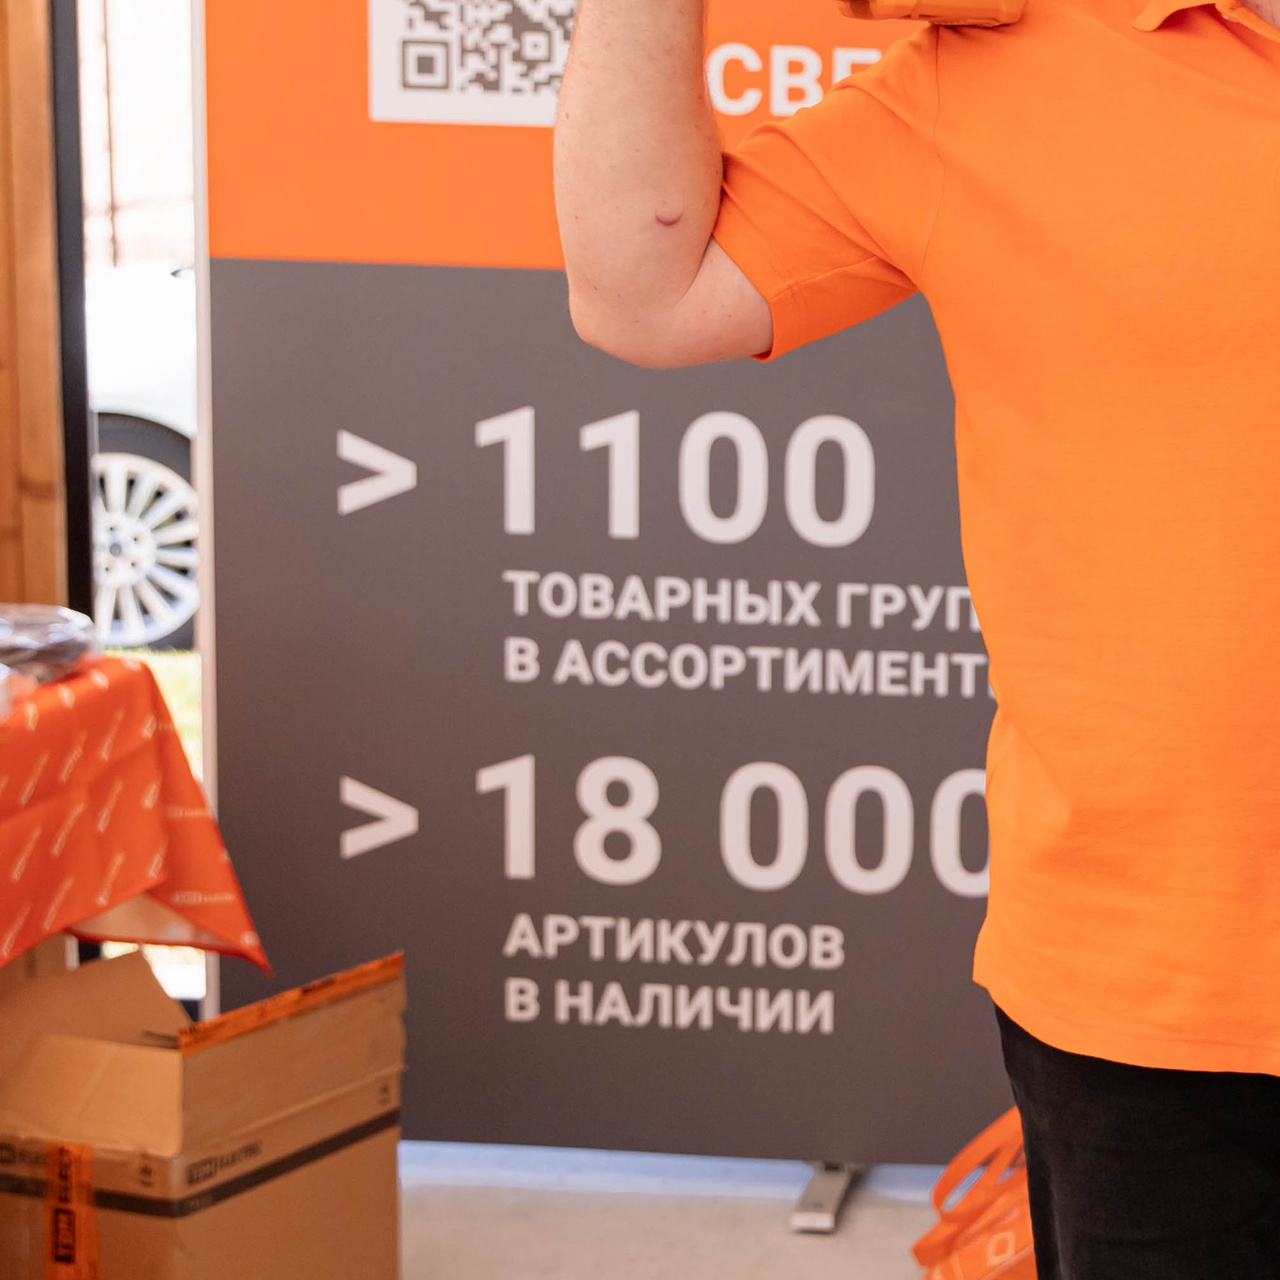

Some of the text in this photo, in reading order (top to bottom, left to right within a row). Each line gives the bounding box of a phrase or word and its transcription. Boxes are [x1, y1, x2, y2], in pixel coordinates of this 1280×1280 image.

[474, 405, 877, 548] 1100
[503, 570, 982, 633] ТОВАРНЫХ ГРУП
[505, 637, 995, 700] В АССОРТИМЕНТ
[475, 754, 664, 886] 18
[719, 761, 990, 899] 000
[503, 913, 846, 971] АРТИКУЛОВ
[505, 977, 836, 1035] В НАЛИЧИИ
